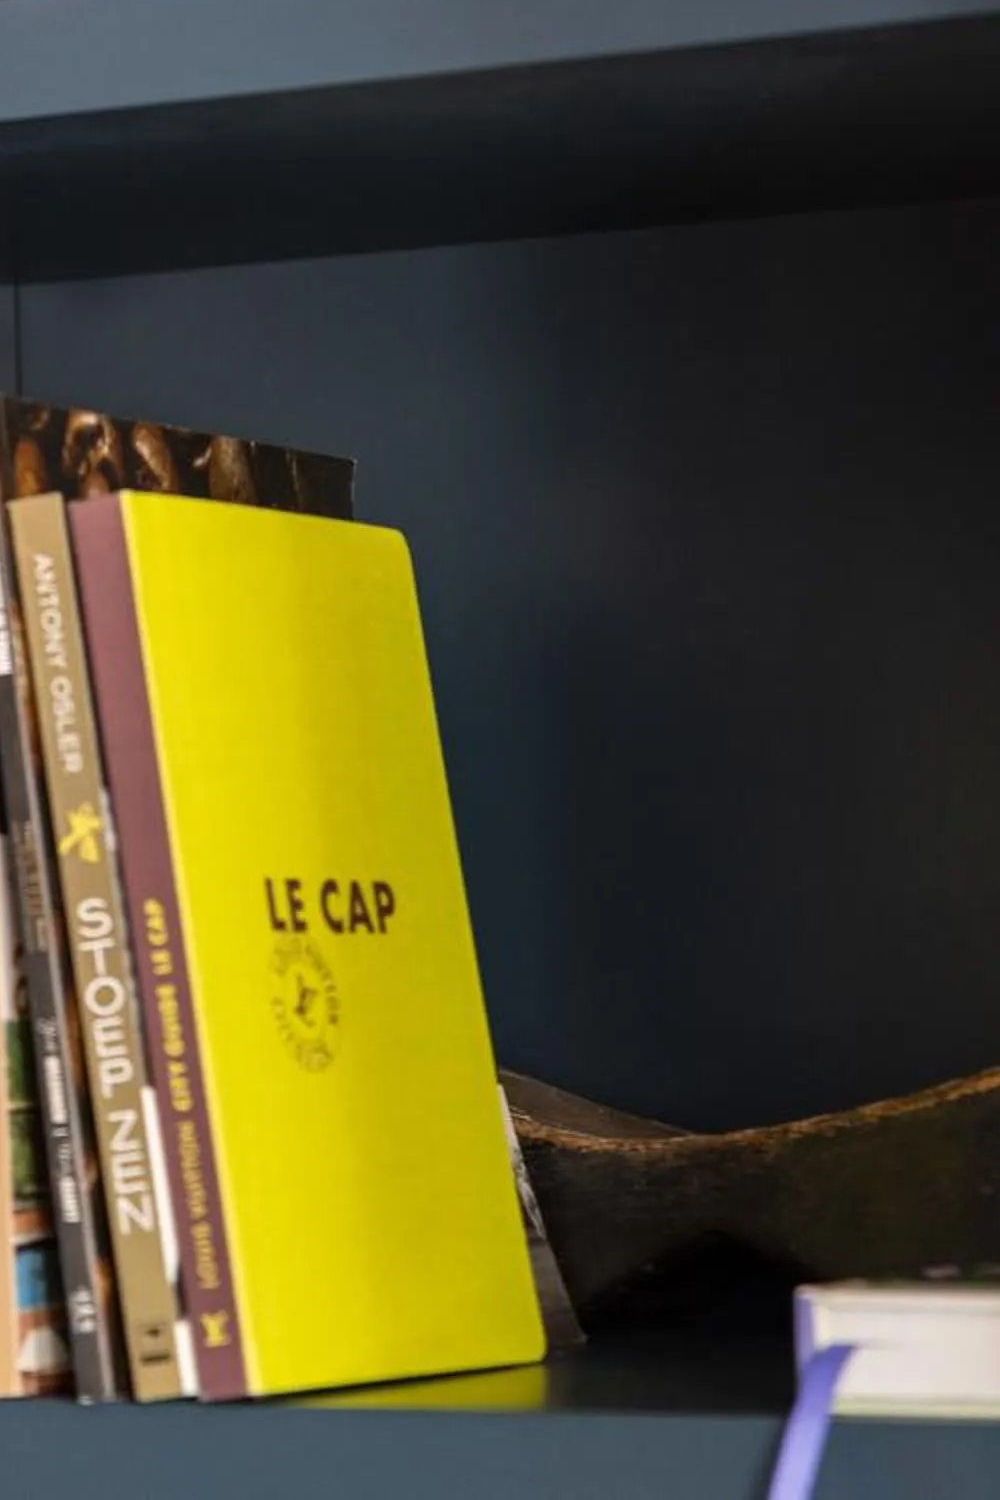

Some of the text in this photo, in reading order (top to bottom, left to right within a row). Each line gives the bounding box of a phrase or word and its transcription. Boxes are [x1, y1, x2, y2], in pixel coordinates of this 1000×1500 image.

[34, 553, 84, 773] ANTONY OSLER
[143, 897, 169, 946] CAP
[264, 876, 396, 934] LE CAP
[154, 983, 186, 1057] GUIDE
[76, 897, 155, 1236] STOEP ZEN
[168, 1060, 194, 1112] CITY
